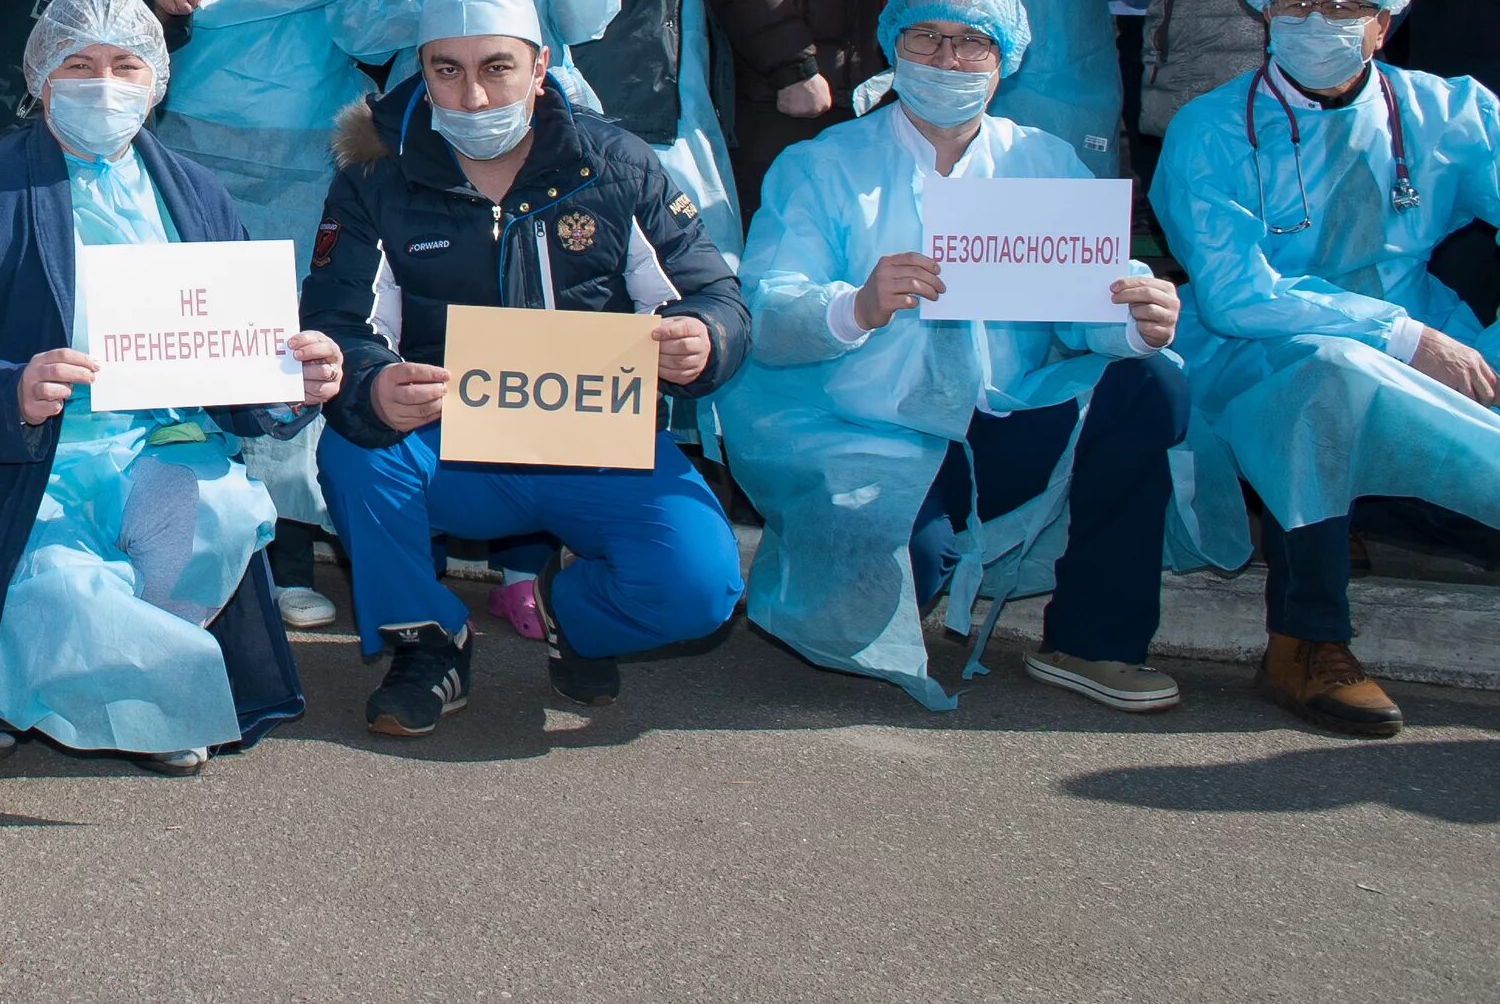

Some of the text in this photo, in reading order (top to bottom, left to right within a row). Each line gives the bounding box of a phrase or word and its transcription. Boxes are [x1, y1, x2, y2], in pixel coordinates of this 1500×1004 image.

[408, 239, 450, 253] FORWARD
[932, 235, 1120, 265] БЕЗОПАСНОСТЬЮ!
[179, 288, 209, 317] НЕ
[103, 322, 287, 363] ПРЕНЕБРЕГАЙТЕ
[458, 364, 642, 415] СВОЕЙ
